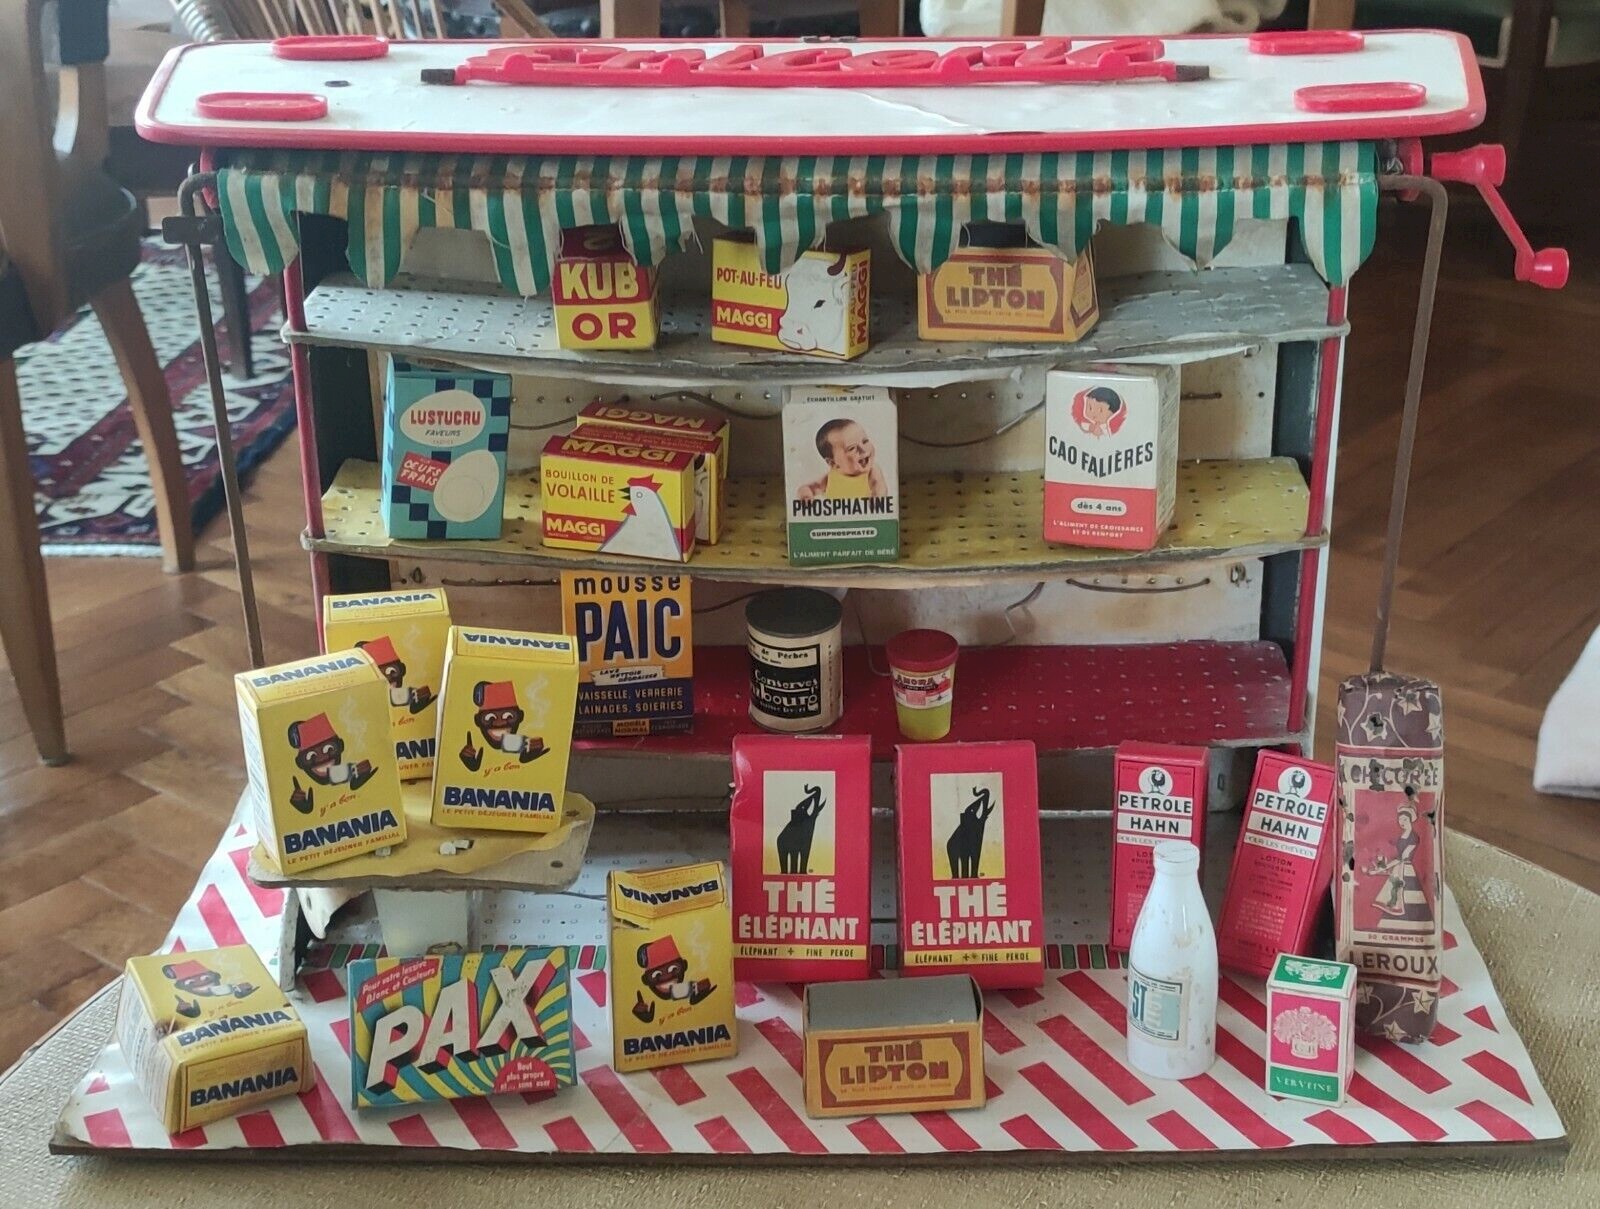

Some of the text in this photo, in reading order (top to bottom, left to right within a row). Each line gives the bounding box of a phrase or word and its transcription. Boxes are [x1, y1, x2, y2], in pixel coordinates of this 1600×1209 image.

[559, 261, 639, 300] KUB
[968, 263, 1022, 288] THÉ
[857, 260, 868, 344] MAGGI
[946, 286, 1045, 311] LIPTON
[571, 311, 637, 341] OR
[716, 307, 772, 332] MAGGI
[410, 409, 481, 426] LUSTUCRU
[595, 407, 705, 429] MAGGI
[561, 439, 676, 463] MAGGI
[1049, 435, 1153, 479] CAO FALIÈRES
[401, 469, 438, 486] FRAIS
[545, 469, 614, 485] BOUILLON DE
[546, 483, 615, 504] VOLAILLE
[792, 496, 894, 517] PHOSPHATINE
[1077, 501, 1122, 512] dès 4 ans
[546, 517, 606, 537] MAGGI
[1053, 519, 1088, 530] L'ALIMENT
[832, 549, 862, 558] PARFAIT
[574, 576, 681, 595] mousse
[332, 592, 437, 609] BANANIA
[463, 632, 570, 650] BANANIA
[575, 598, 681, 662] PAIC
[252, 656, 365, 688] BANANIA
[635, 687, 683, 698] VERRERIE
[635, 701, 683, 713] SOIERIES
[503, 761, 521, 772] bon
[443, 786, 556, 812] BANANIA
[1119, 792, 1192, 814] PETROLE
[1255, 792, 1326, 820] PETROLE
[455, 809, 475, 817] PETIT
[519, 812, 554, 820] FAMILIAL
[1130, 816, 1179, 834] HAHN
[283, 809, 398, 855] BANANIA
[1260, 816, 1310, 840] HAHN
[300, 851, 320, 862] PETIT
[366, 831, 401, 846] FAMILIAL
[1261, 855, 1293, 867] LOTION
[618, 879, 719, 906] BANANIA
[763, 880, 835, 914] THÉ
[933, 881, 1008, 918] THÉ
[738, 915, 859, 940] ÉLÉPHANT
[911, 920, 1032, 946] ÉLÉPHANT
[1381, 934, 1424, 944] GRAMMES
[805, 948, 822, 957] FINE
[830, 948, 854, 957] PEKOE
[981, 952, 998, 962] FINE
[1006, 952, 1030, 961] PEKOE
[1350, 951, 1439, 975] LEROUX
[362, 959, 427, 995] Pour votre lessive
[366, 968, 436, 1005] Blanc et Couleurs
[176, 1010, 292, 1047] BANANIA
[367, 958, 557, 1096] PAX
[623, 1024, 731, 1056] BANANIA
[864, 1039, 923, 1063] THÉ
[840, 1060, 949, 1086] LIPTON
[190, 1066, 298, 1107] BANANIA
